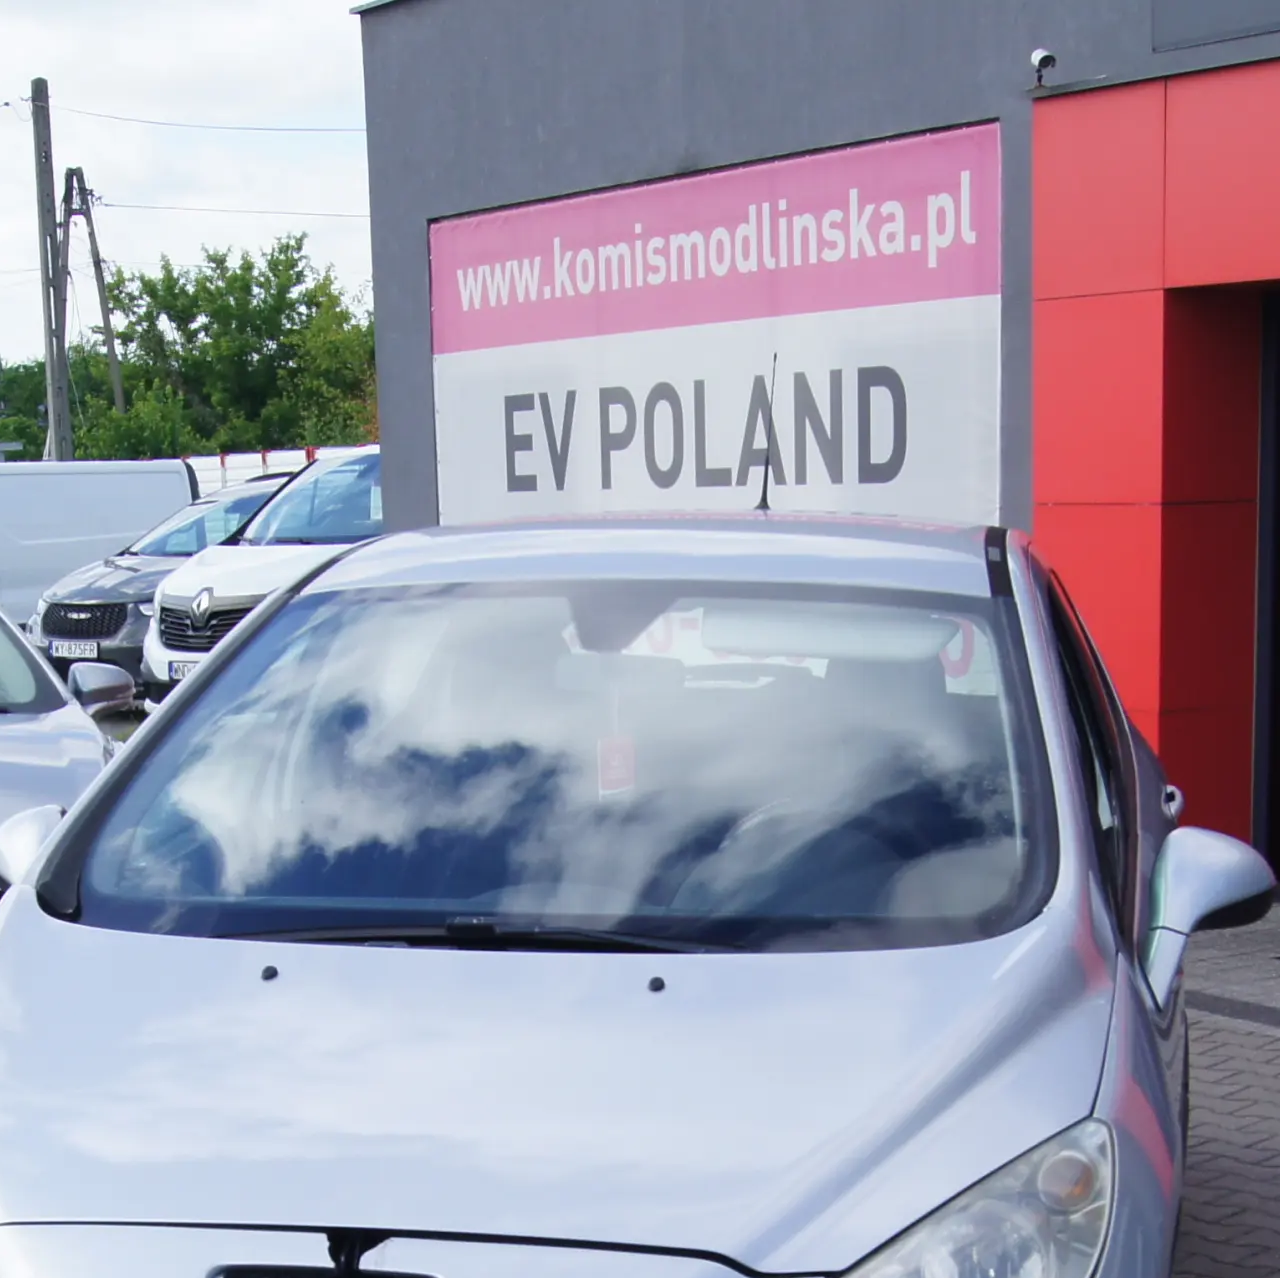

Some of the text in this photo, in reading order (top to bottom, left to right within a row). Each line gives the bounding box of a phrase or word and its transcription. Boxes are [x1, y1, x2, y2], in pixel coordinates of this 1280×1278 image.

[457, 170, 977, 311] www.komismodlinska.pl
[504, 365, 907, 493] EV POLAND
